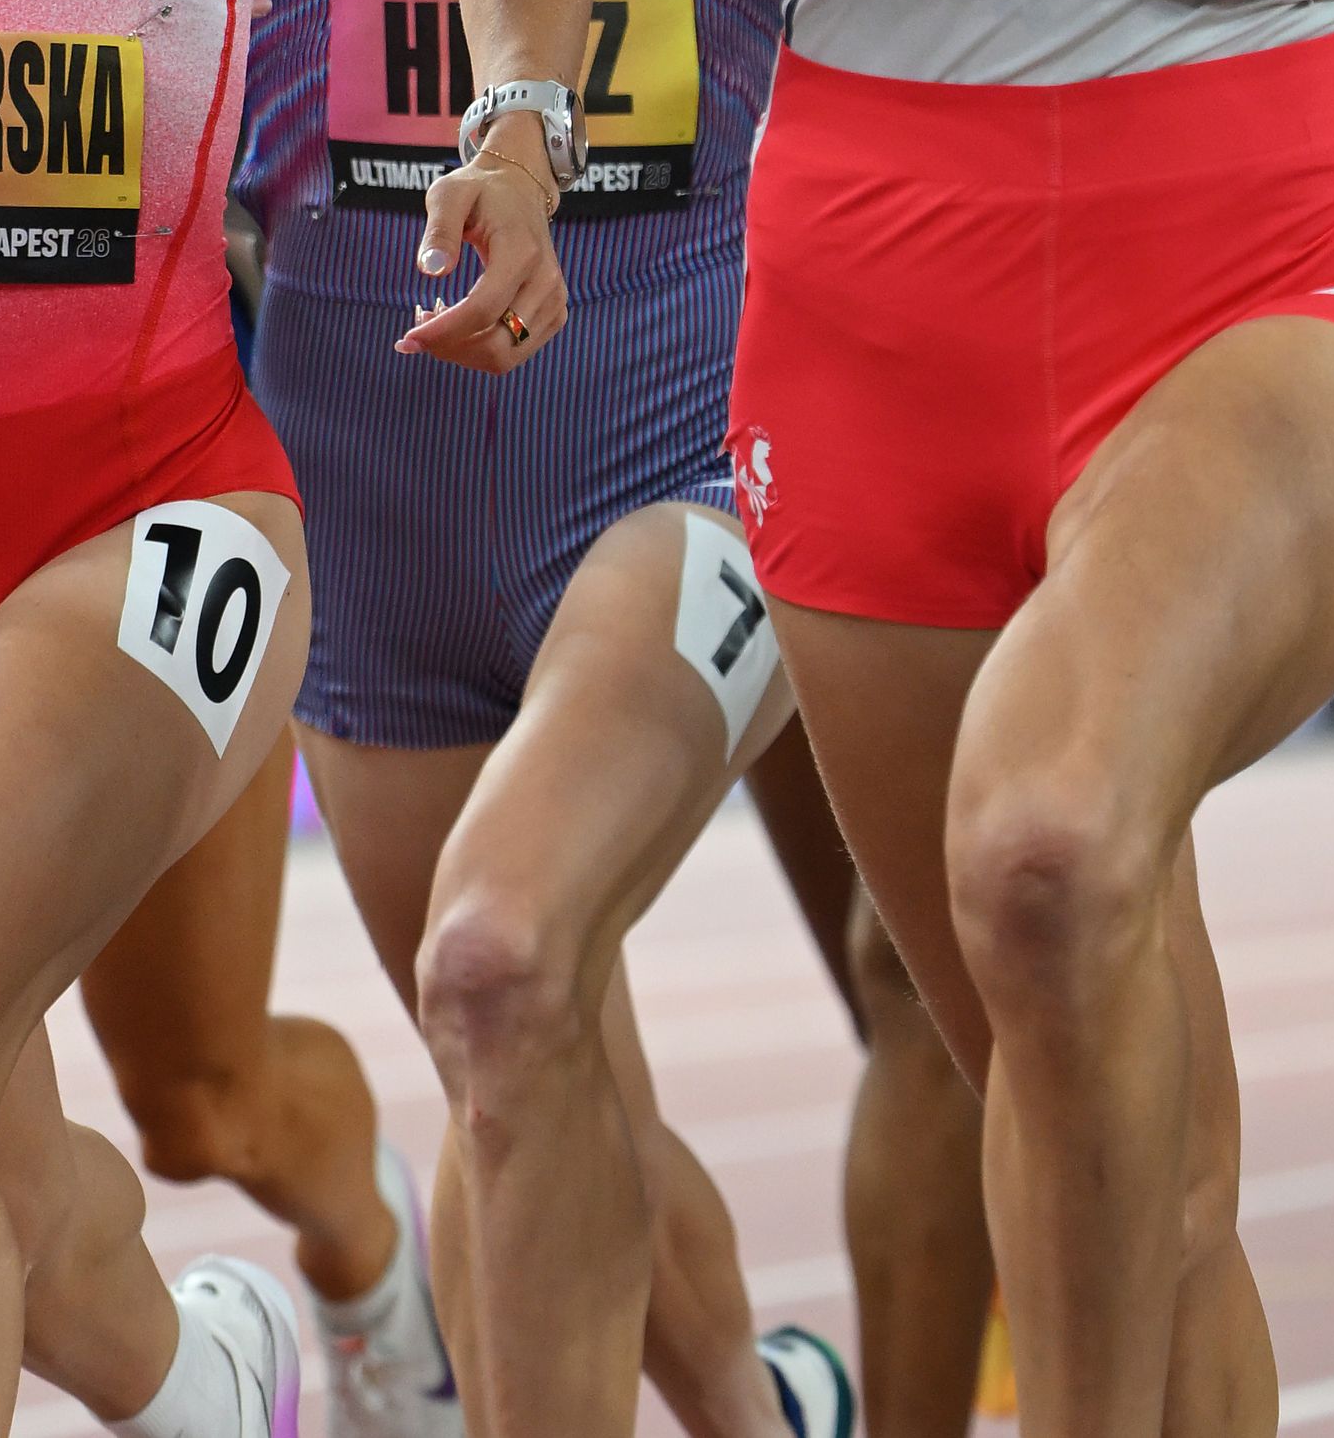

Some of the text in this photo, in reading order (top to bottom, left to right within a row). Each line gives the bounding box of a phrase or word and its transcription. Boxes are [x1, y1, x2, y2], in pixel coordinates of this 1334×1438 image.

[76, 228, 110, 259] 26
[144, 522, 262, 704] 10
[711, 558, 767, 679] 7
